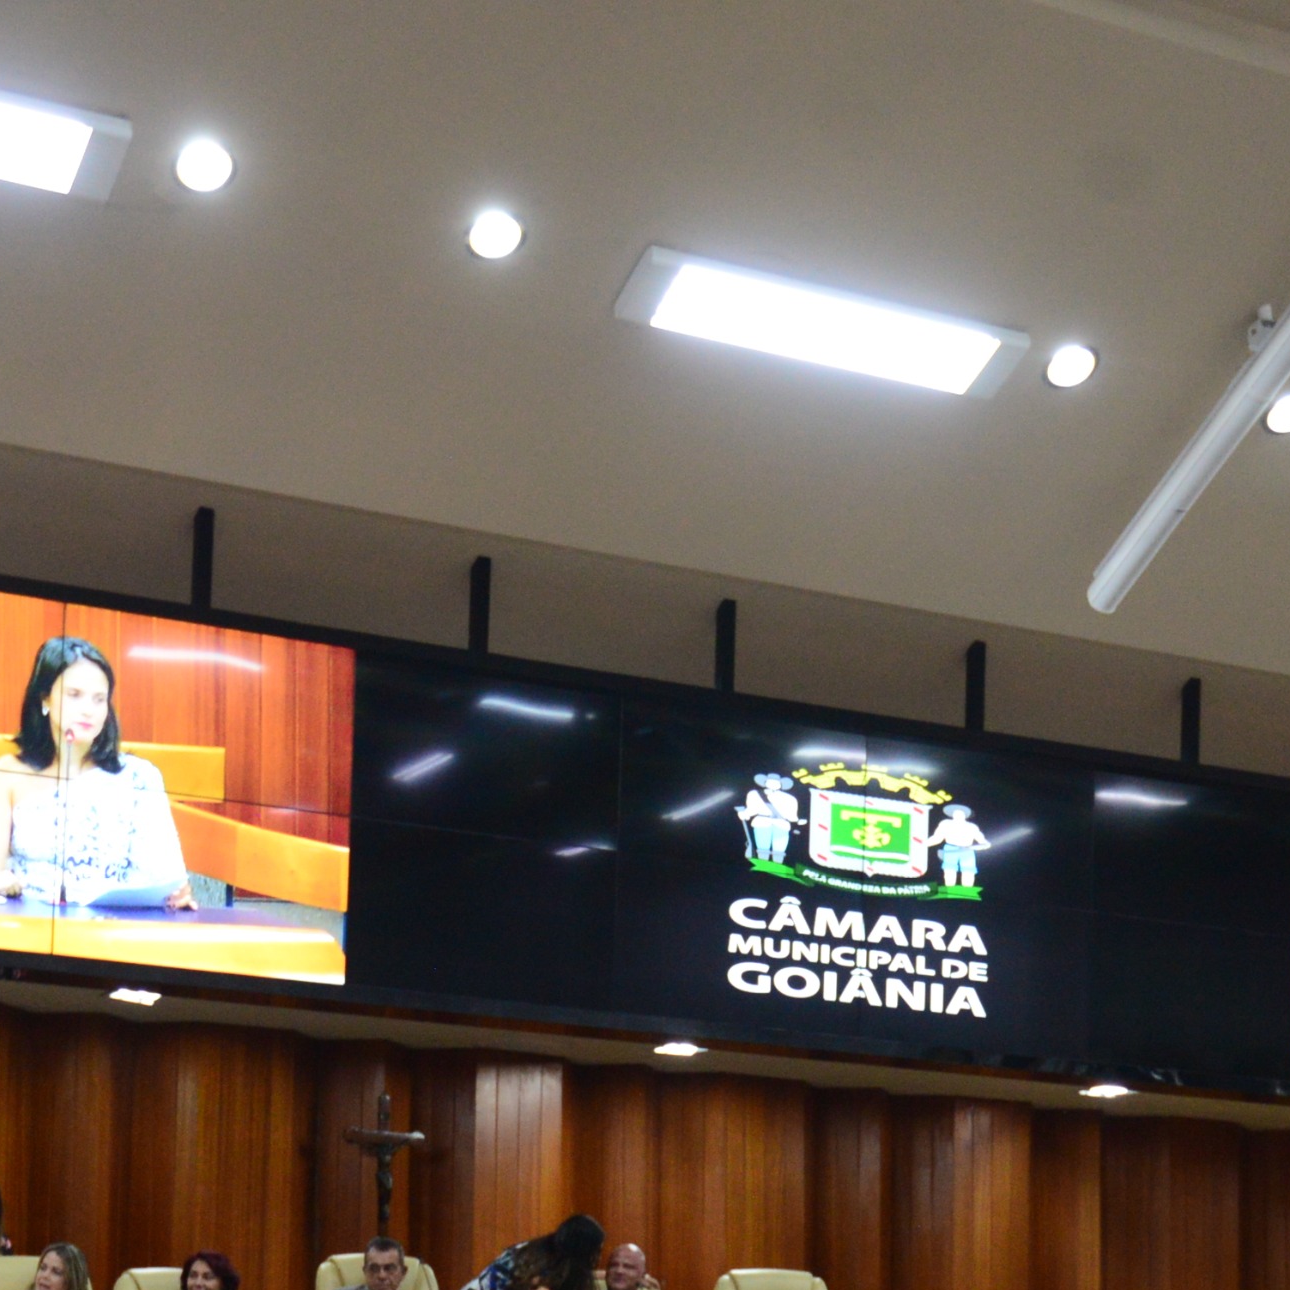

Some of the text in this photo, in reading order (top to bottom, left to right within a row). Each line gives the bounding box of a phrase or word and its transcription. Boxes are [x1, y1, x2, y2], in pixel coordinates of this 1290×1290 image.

[728, 896, 988, 956] CÂMARA
[728, 933, 989, 982] MUNICIPAL DE
[727, 961, 987, 1018] GOIÂNIA
